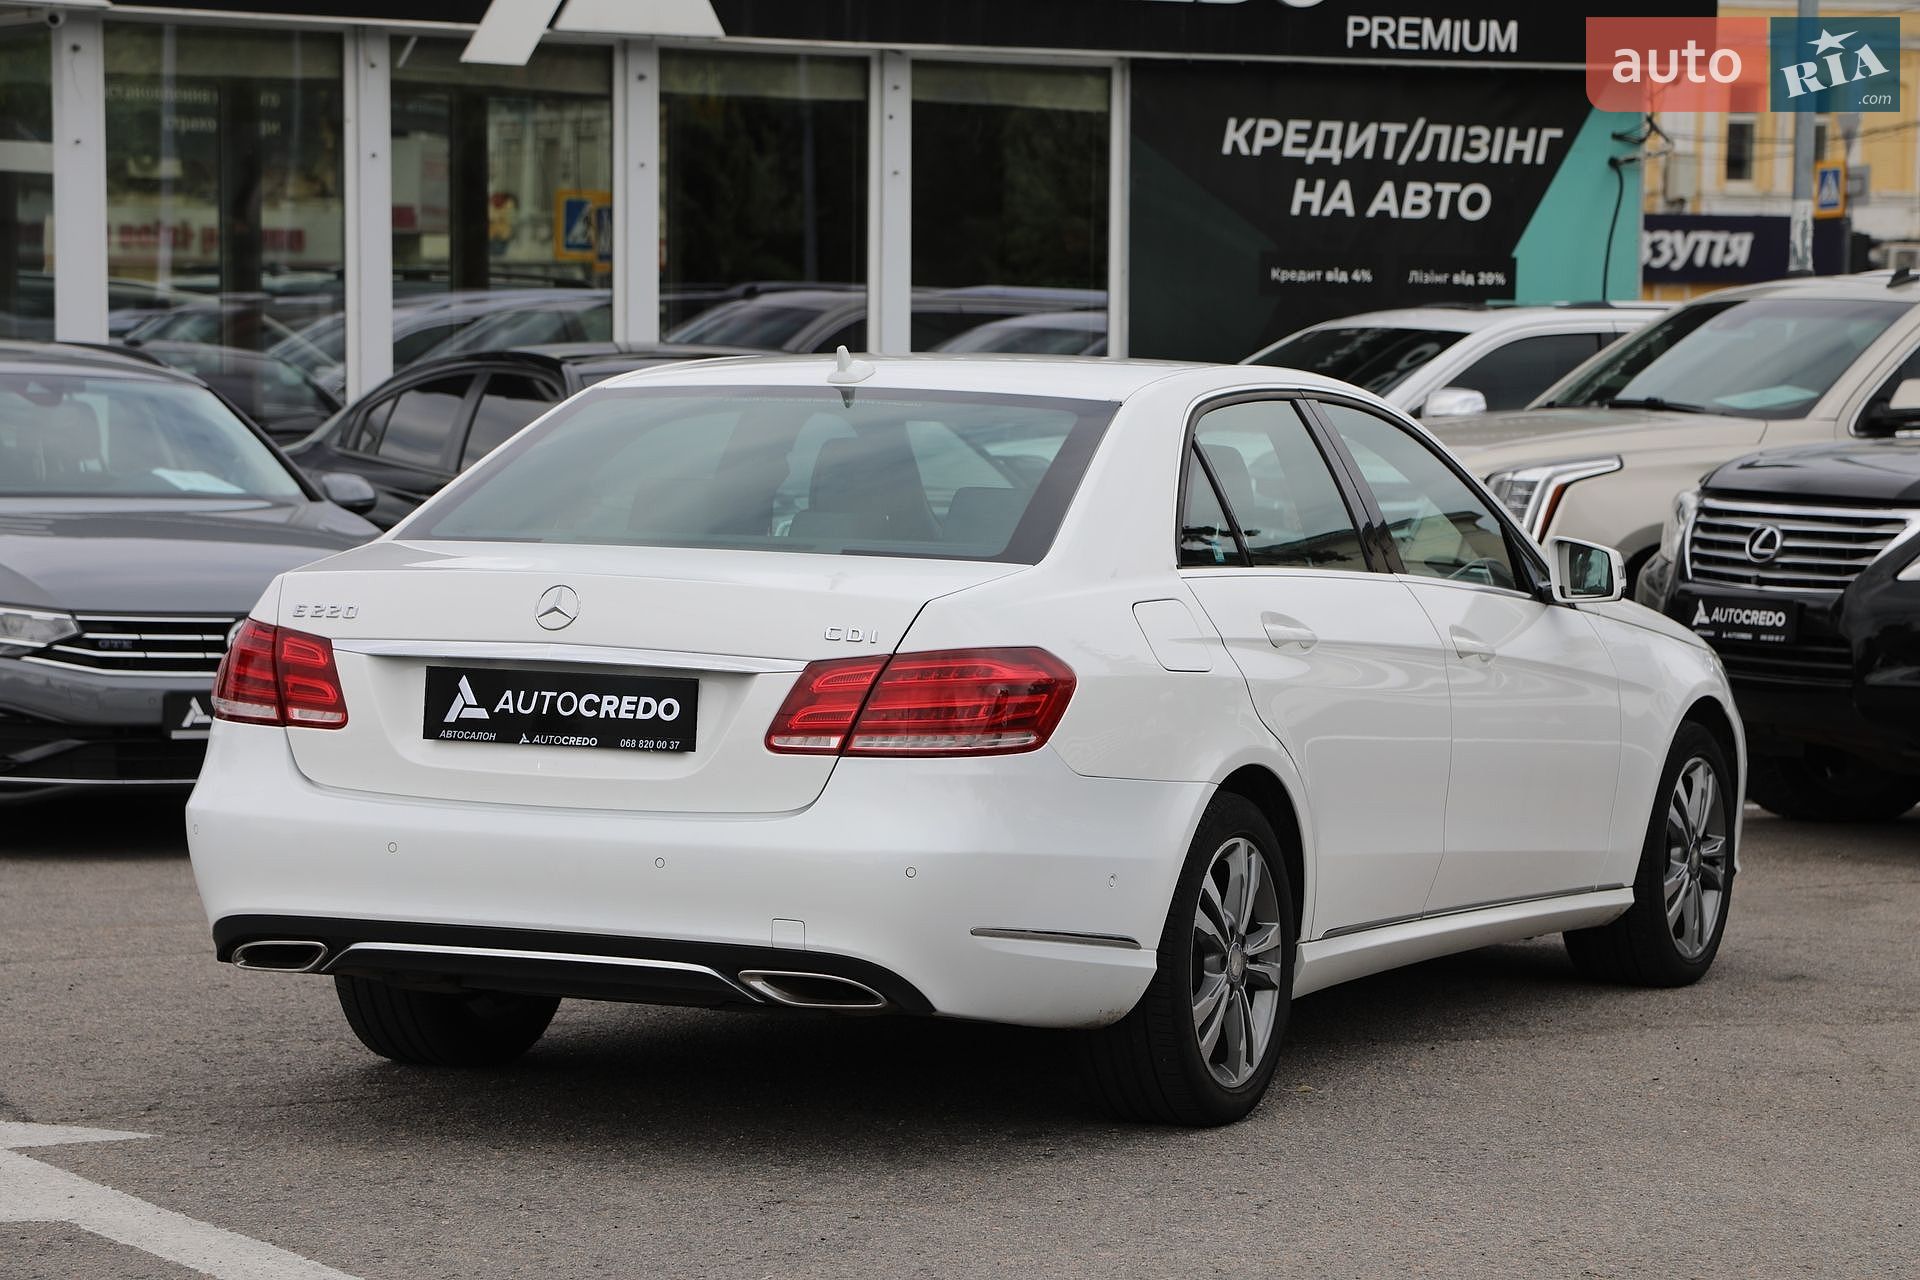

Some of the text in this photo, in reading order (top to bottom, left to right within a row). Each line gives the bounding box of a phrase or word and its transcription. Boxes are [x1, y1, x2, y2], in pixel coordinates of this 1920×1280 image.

[1346, 16, 1519, 53] PREMIUM
[1221, 117, 1564, 165] КРЕДИТ/ЛІЗІНГ
[1290, 179, 1492, 221] НА АВТО
[1271, 267, 1373, 283] Кредит від 4%
[1408, 270, 1506, 287] Лізінг від 20%
[1711, 606, 1786, 627] AUTOCREDO
[824, 626, 879, 643] CDI
[494, 690, 680, 722] AUTOCREDO
[439, 729, 497, 741] АВТОСАЛОН
[532, 735, 598, 747] AUTOCREDO
[620, 738, 680, 750] 068 820 00 37
